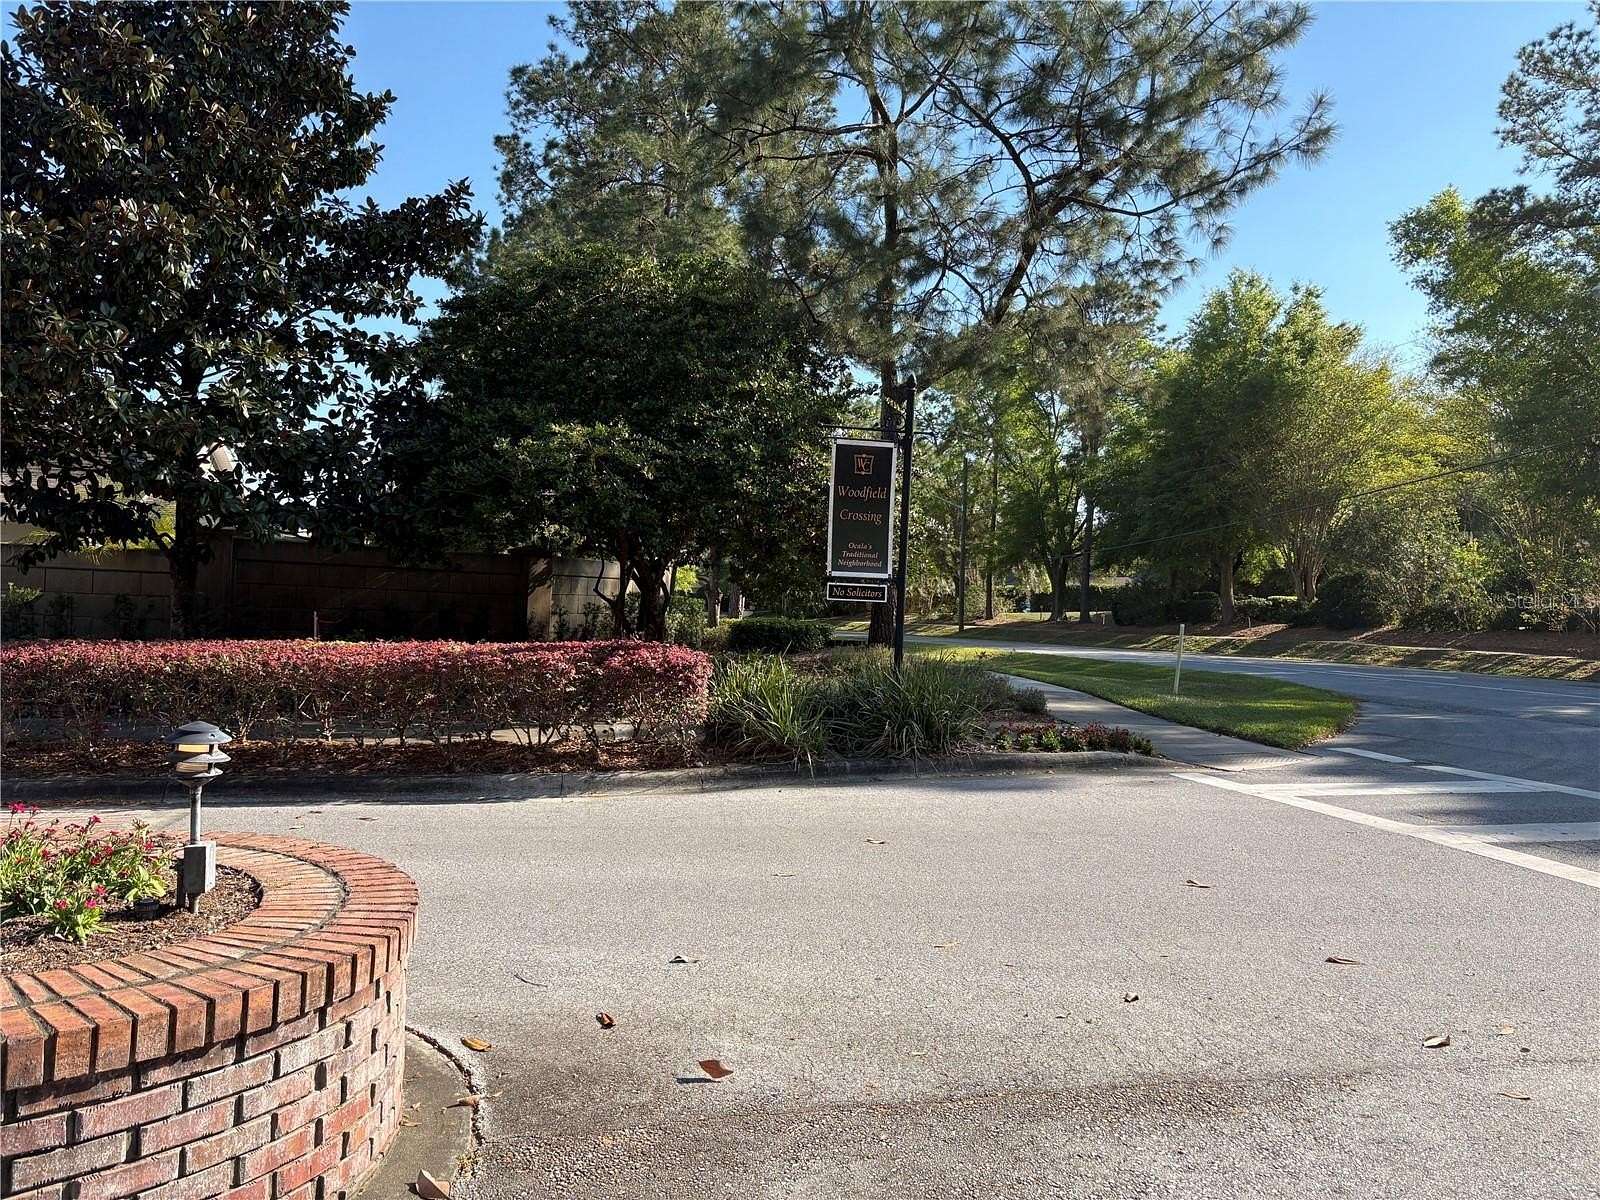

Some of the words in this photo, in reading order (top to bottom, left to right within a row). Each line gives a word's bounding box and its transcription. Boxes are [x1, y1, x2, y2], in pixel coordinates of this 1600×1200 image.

[838, 485, 887, 500] Woodfield
[840, 509, 882, 526] Crossing
[848, 542, 872, 550] Ocala's
[842, 551, 879, 559] Traditional
[838, 560, 882, 568] Neighborhood
[832, 587, 844, 596] No
[847, 588, 882, 598] Solicitors
